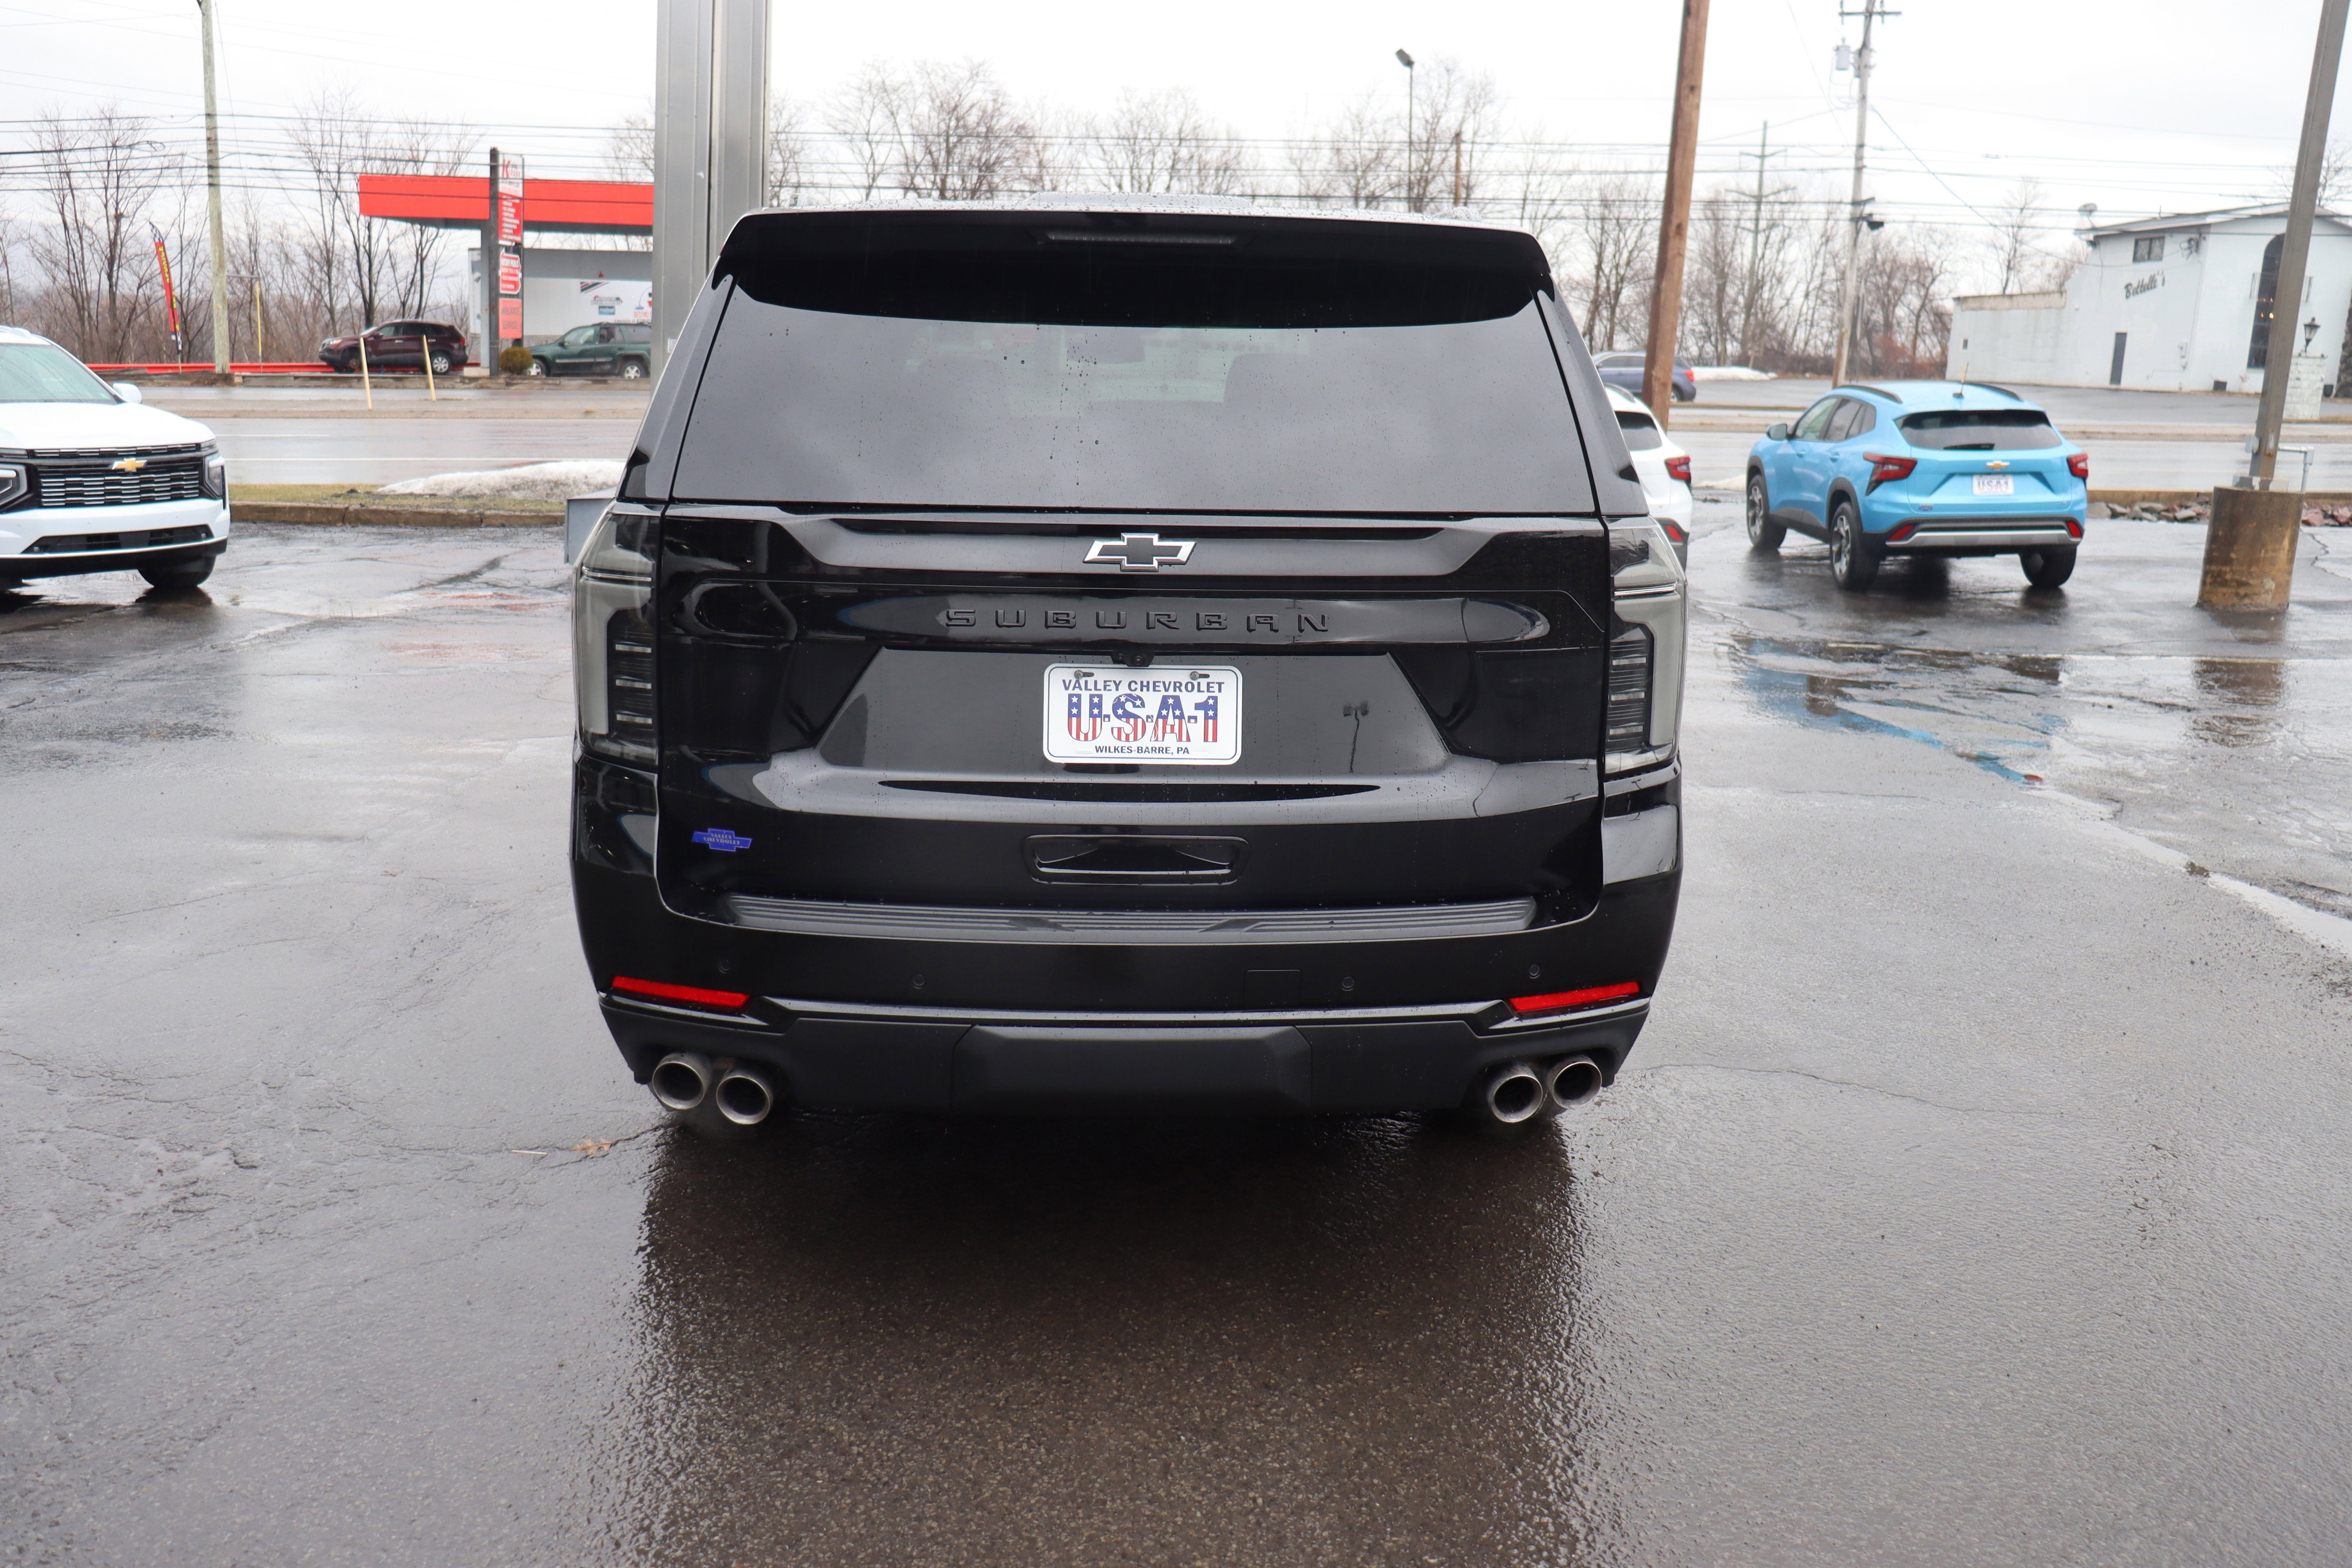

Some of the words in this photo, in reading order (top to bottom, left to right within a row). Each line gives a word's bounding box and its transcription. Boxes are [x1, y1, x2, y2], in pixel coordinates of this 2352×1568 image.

[946, 609, 1329, 632] SUBURBAN
[1062, 679, 1123, 692] VALLEY
[1127, 680, 1225, 693] CHEVROLET
[1095, 746, 1174, 756] WILKES-BARRE,
[703, 837, 740, 845] CHEVROLET
